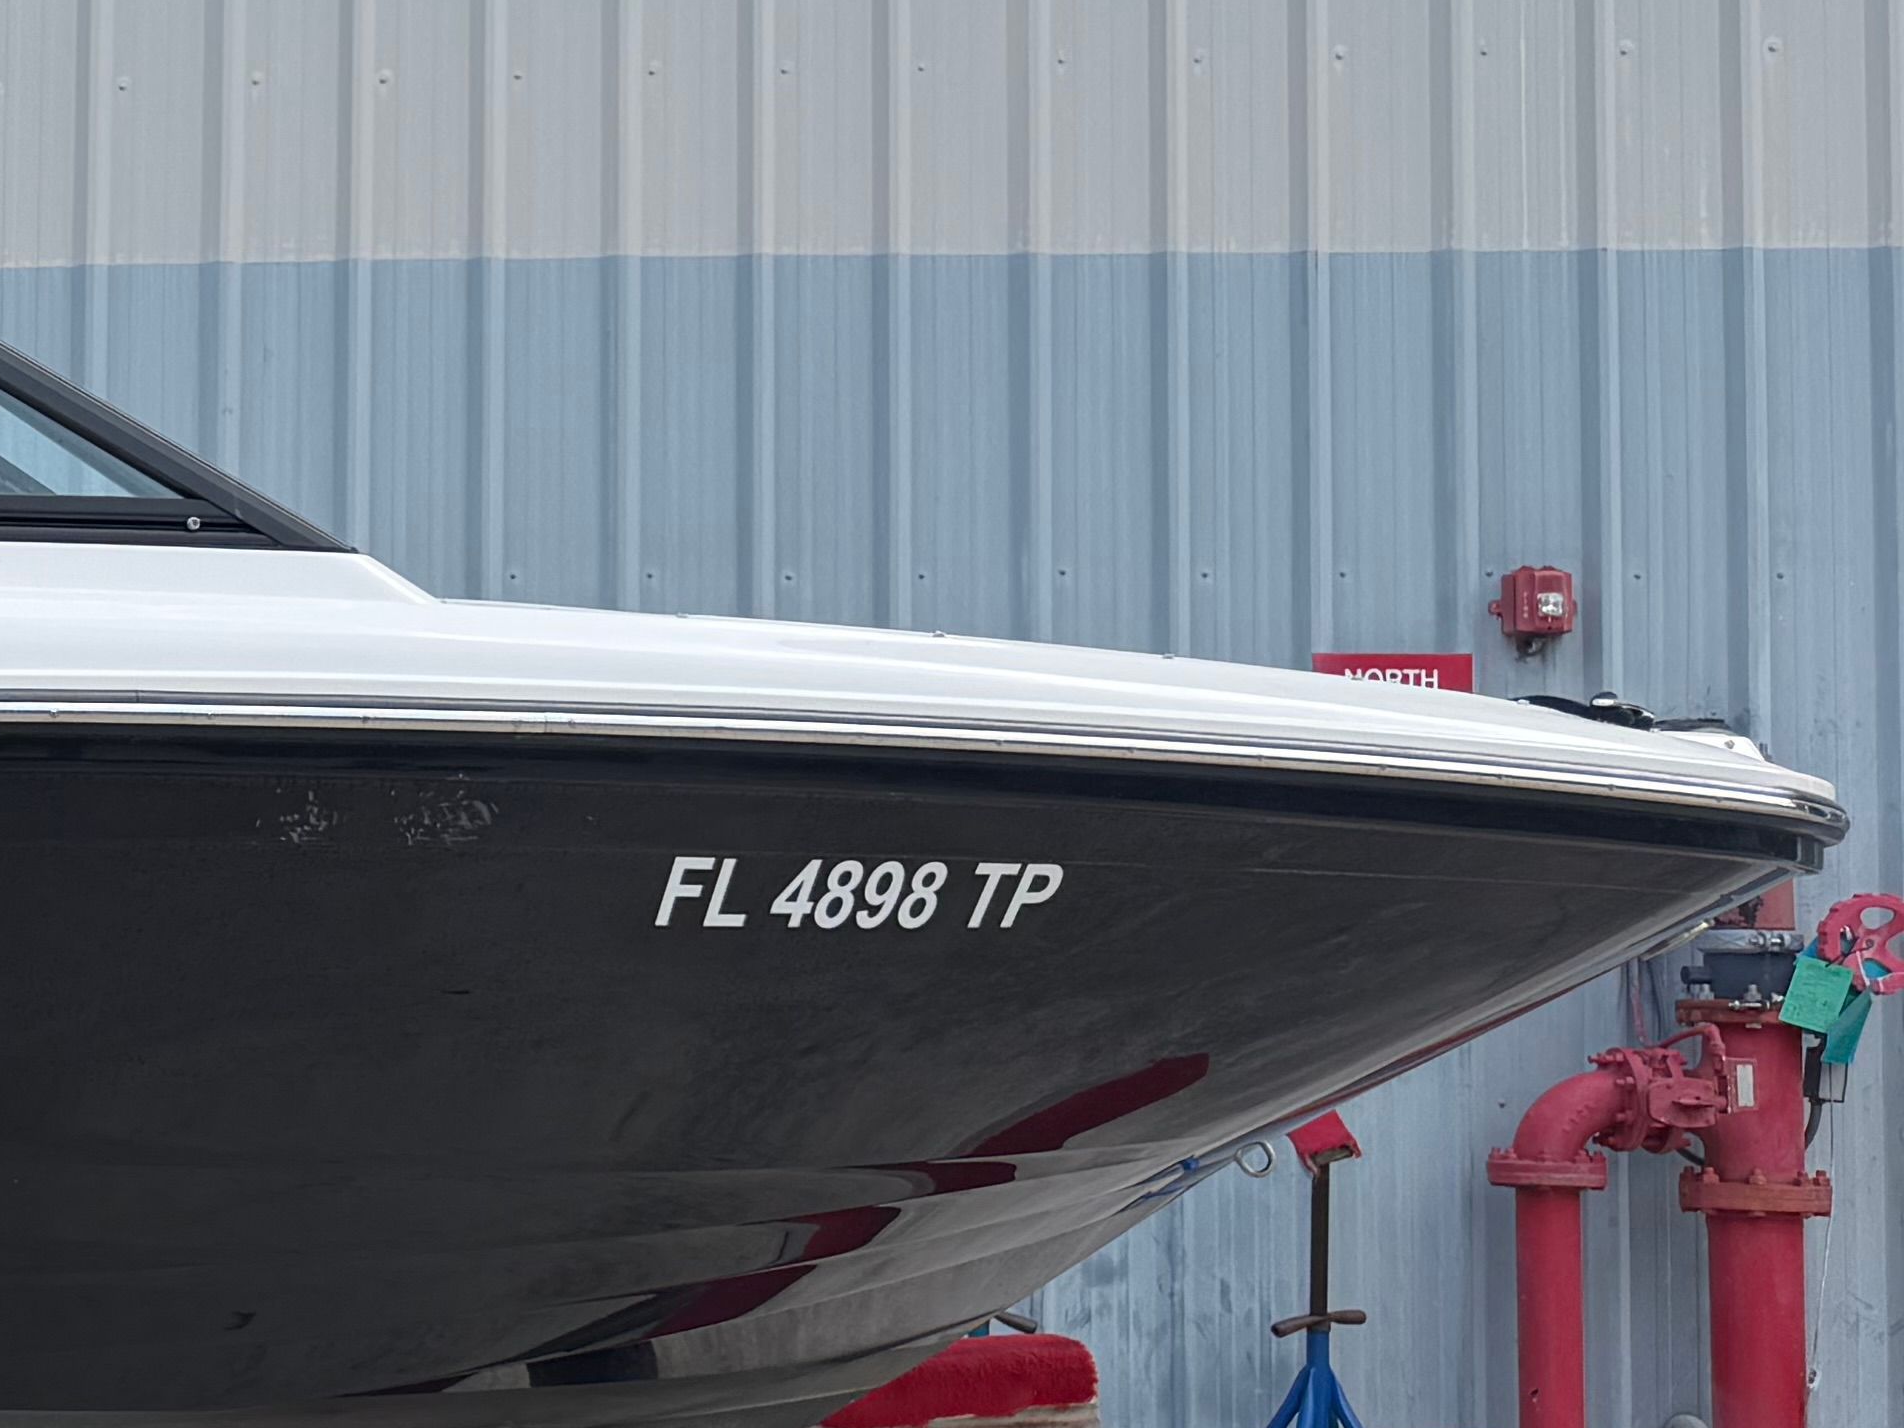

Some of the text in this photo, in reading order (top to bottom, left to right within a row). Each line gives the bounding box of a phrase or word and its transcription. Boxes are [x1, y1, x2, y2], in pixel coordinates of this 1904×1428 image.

[654, 856, 1064, 929] FL 4898 TP
